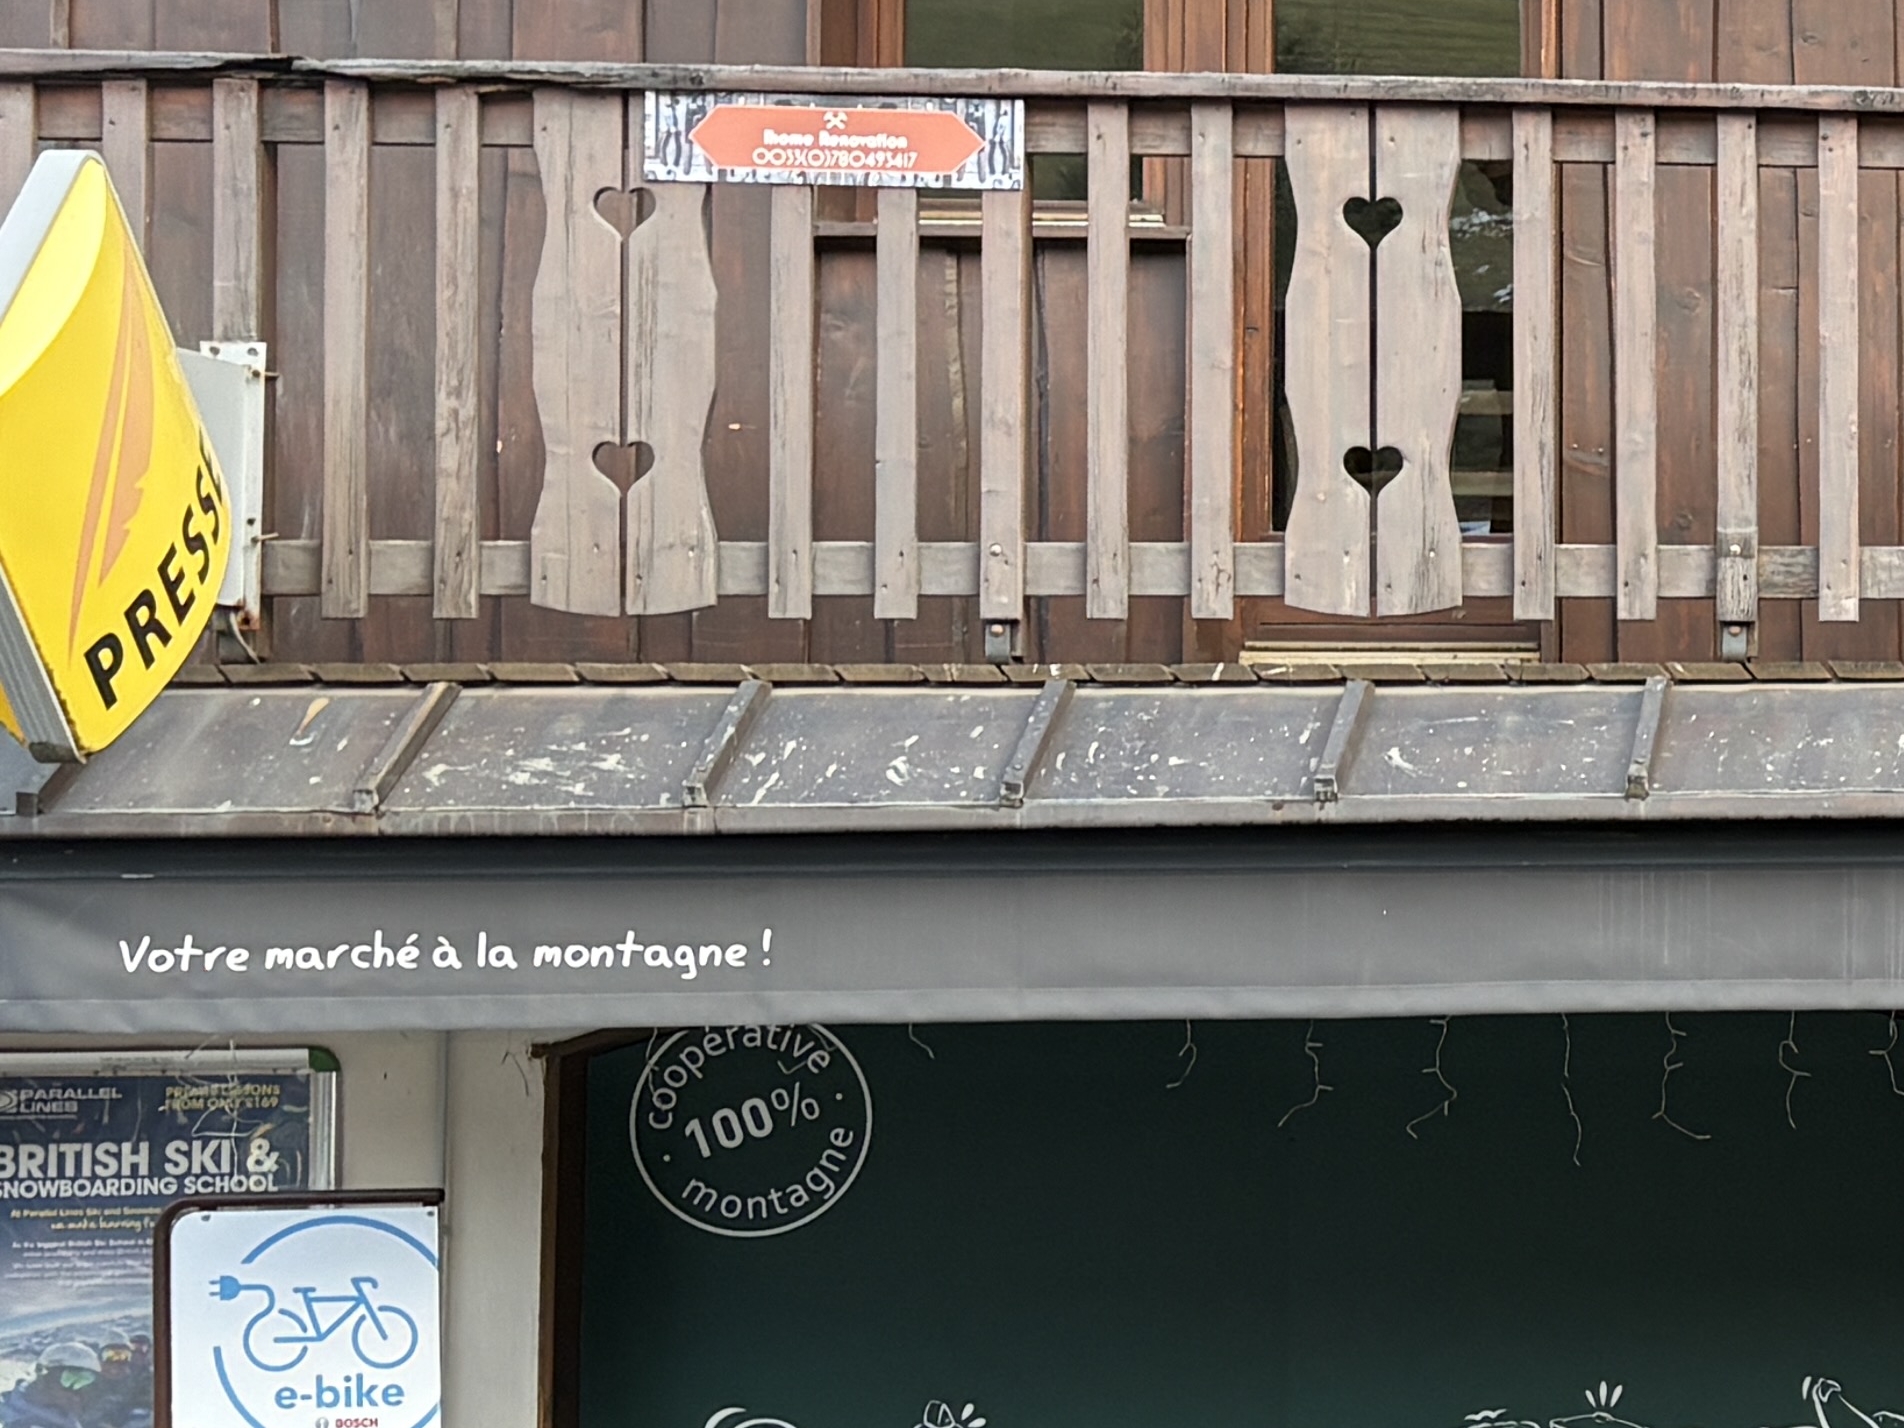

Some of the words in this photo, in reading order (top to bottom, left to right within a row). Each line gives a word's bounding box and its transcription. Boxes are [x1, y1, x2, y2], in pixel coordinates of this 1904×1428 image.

[118, 934, 248, 974] Votre
[264, 929, 420, 971] marché
[431, 936, 463, 971] à
[476, 931, 519, 970] la
[532, 929, 749, 980] montagne
[20, 1086, 123, 1100] PARALLEL
[648, 1023, 832, 1130] coopérative
[20, 1100, 78, 1113] LINES
[684, 1081, 821, 1159] 100%
[0, 1141, 150, 1180] BRITISH
[164, 1139, 231, 1176] SKI
[246, 1137, 280, 1173] &
[681, 1126, 854, 1220] montagne
[0, 1177, 178, 1199] NOWBOARDING
[184, 1172, 279, 1194] SCHOOL
[274, 1372, 405, 1410] e-bike
[335, 1418, 379, 1428] BOSCH
